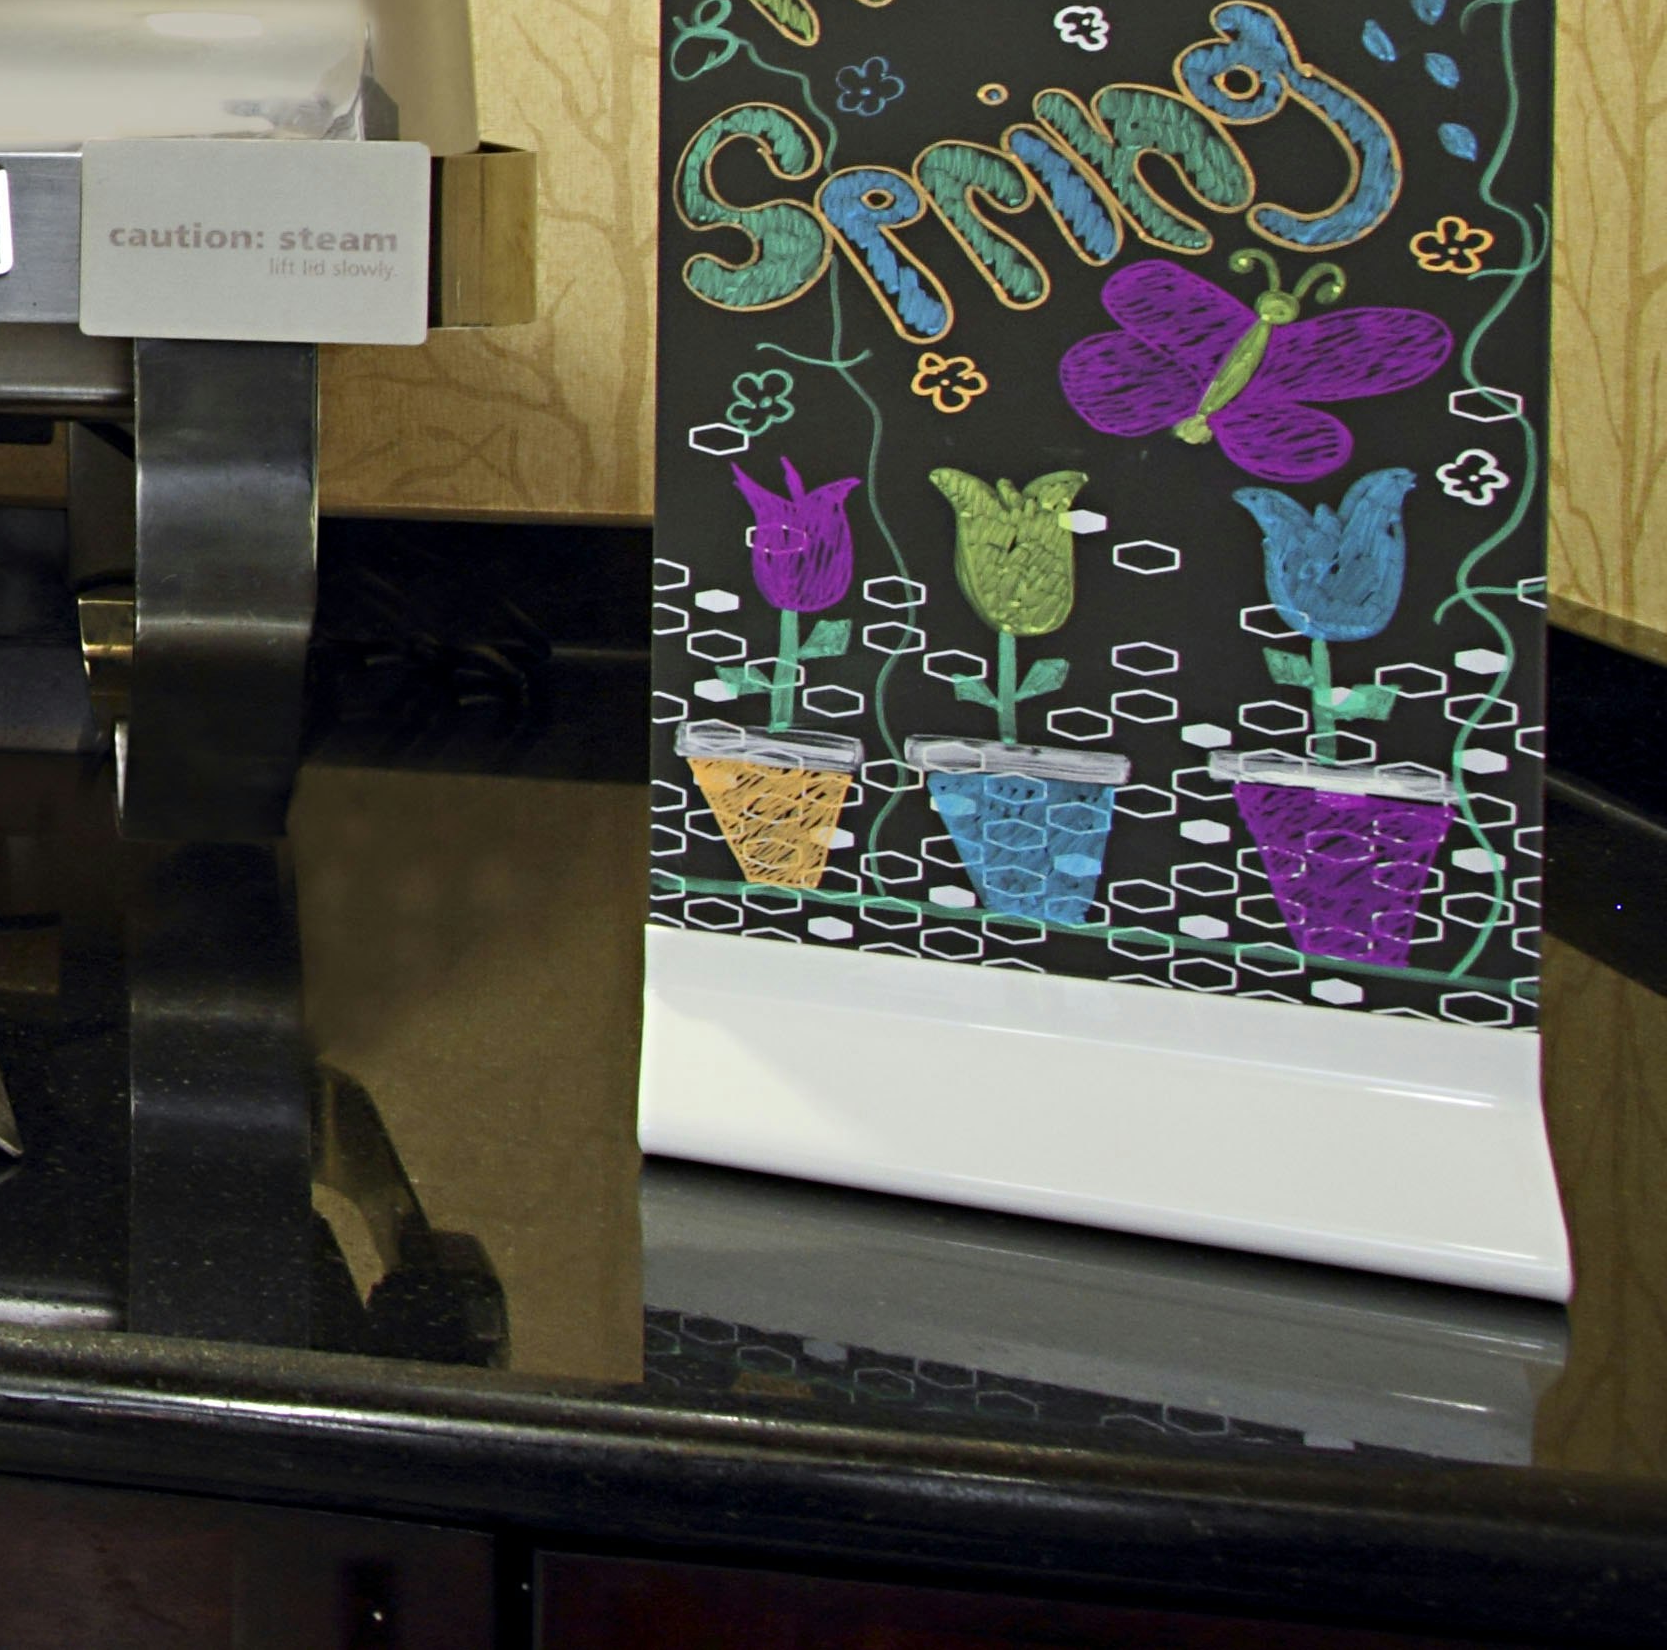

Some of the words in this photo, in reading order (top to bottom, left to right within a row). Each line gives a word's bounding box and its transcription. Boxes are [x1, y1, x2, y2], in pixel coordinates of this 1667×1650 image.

[108, 222, 265, 250] caution:
[278, 226, 399, 252] steam
[269, 257, 295, 276] lift
[303, 259, 326, 277] lid
[330, 259, 399, 282] slowly.
